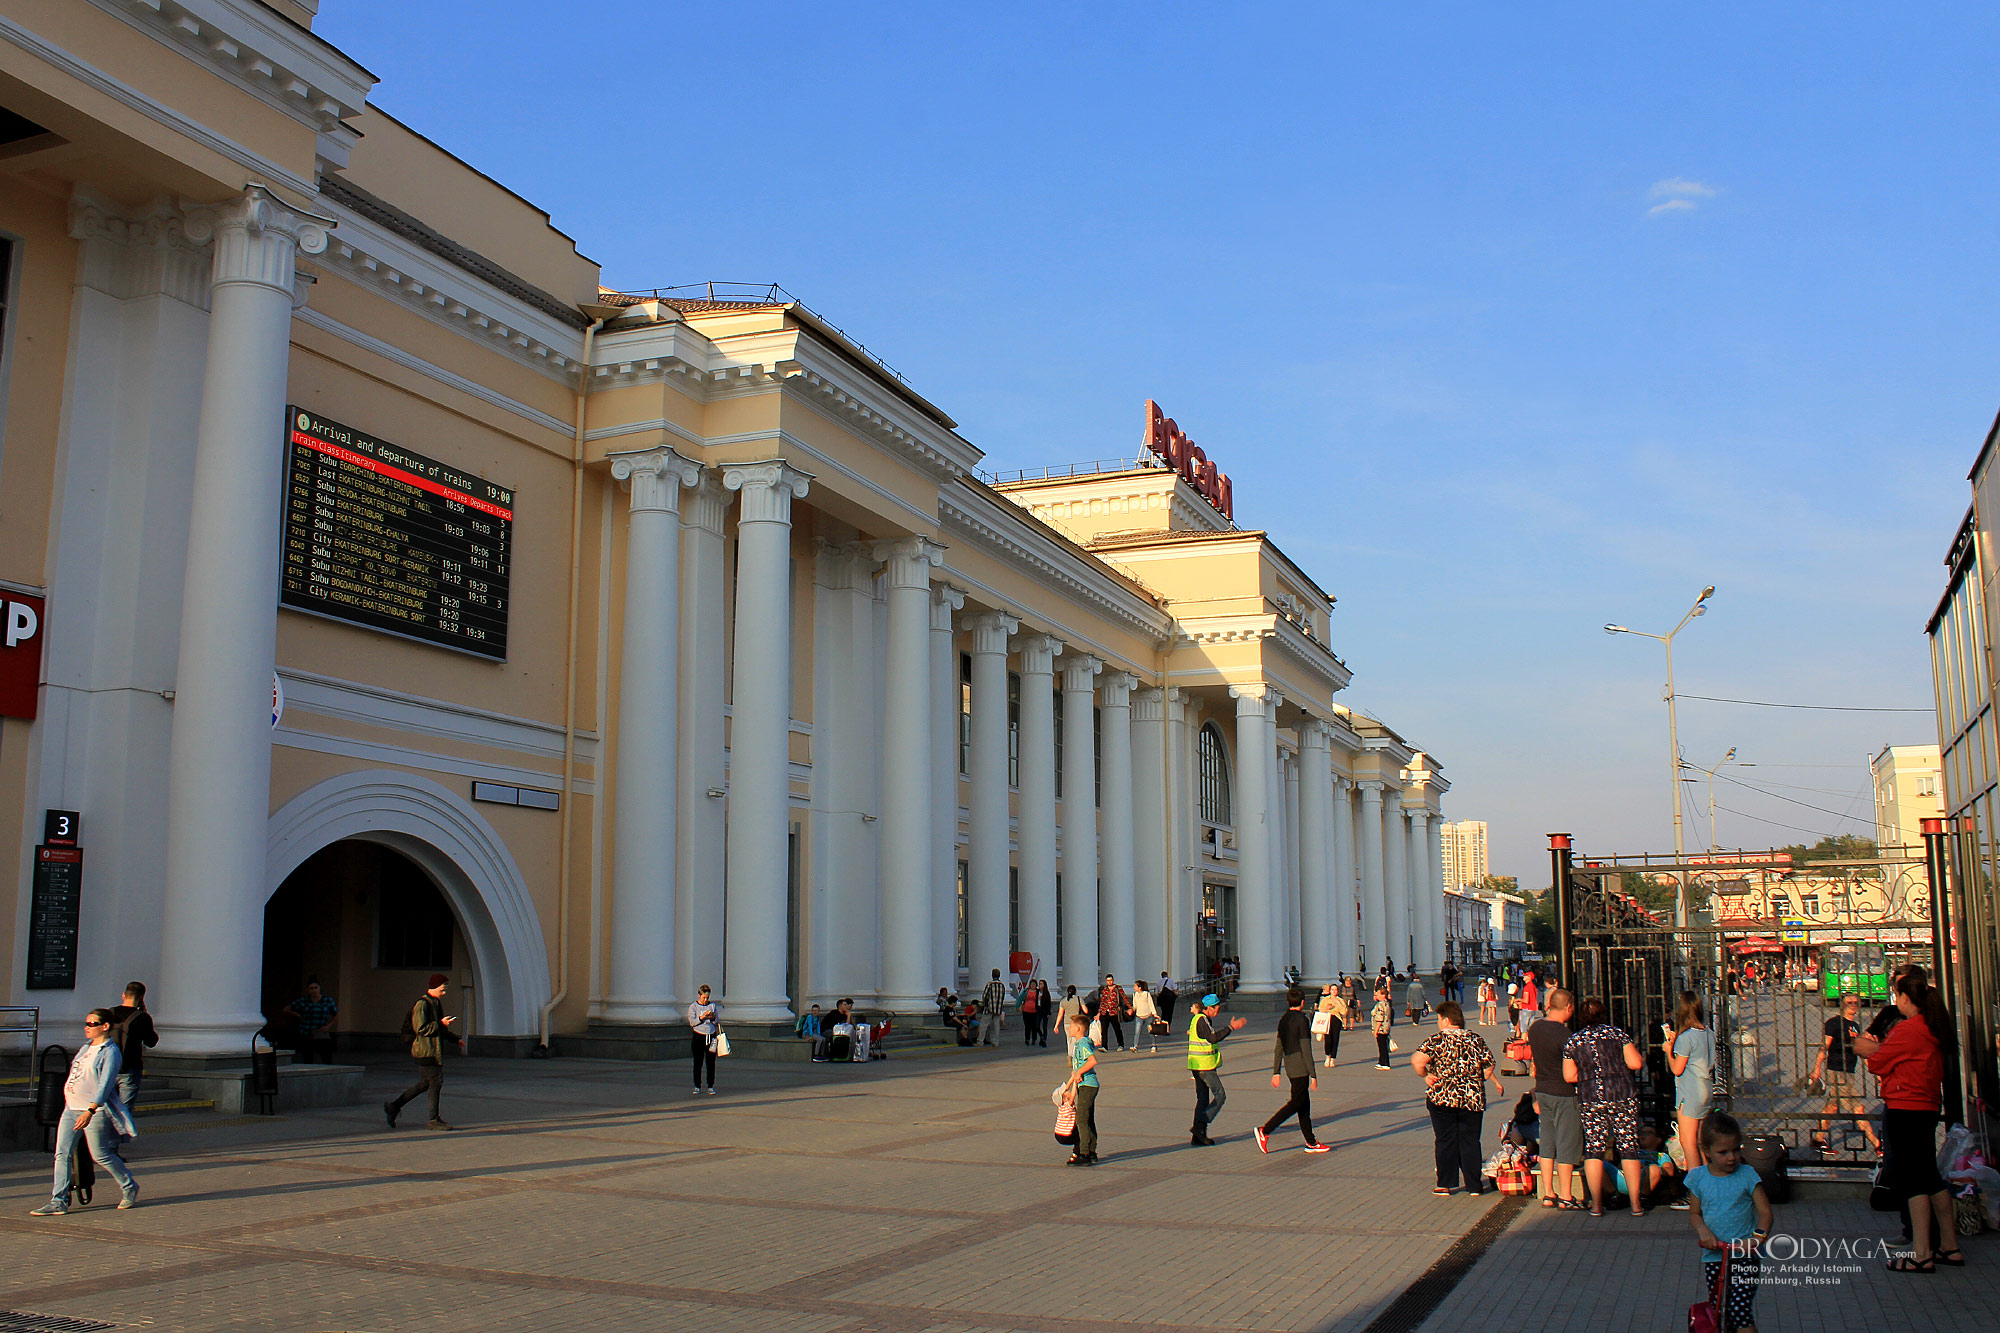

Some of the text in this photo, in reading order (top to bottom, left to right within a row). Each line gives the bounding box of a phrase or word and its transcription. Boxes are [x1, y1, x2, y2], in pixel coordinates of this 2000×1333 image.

[296, 433, 511, 519] Train Class Itinerary Arrives Departs Track
[312, 420, 511, 504] Arrival and departure of trains 19:00
[320, 453, 337, 467] Subu
[446, 500, 464, 513] 18:56
[501, 519, 505, 528] 5
[316, 492, 335, 506] Subu
[317, 479, 335, 493] Subu
[445, 524, 464, 537] 19:03
[500, 543, 504, 551] 3
[318, 466, 336, 480] Last
[472, 521, 490, 534] 19:03
[501, 531, 504, 539] 8
[314, 518, 333, 532] Subu
[443, 560, 461, 572] 19:11
[314, 531, 332, 546] City
[442, 572, 461, 584] 19:12
[469, 580, 487, 593] 19:23
[316, 505, 334, 519] Subu
[471, 556, 488, 569] 19:11
[498, 565, 504, 574] 11
[311, 571, 329, 584] Subu
[440, 608, 459, 620] 19:20
[312, 545, 331, 558] Subu
[469, 592, 487, 604] 19:15
[312, 558, 330, 571] Subu
[441, 596, 459, 608] 19:20
[309, 585, 328, 600] City
[439, 620, 458, 633] 19:32
[467, 628, 485, 640] 19:34
[57, 816, 70, 836] 3
